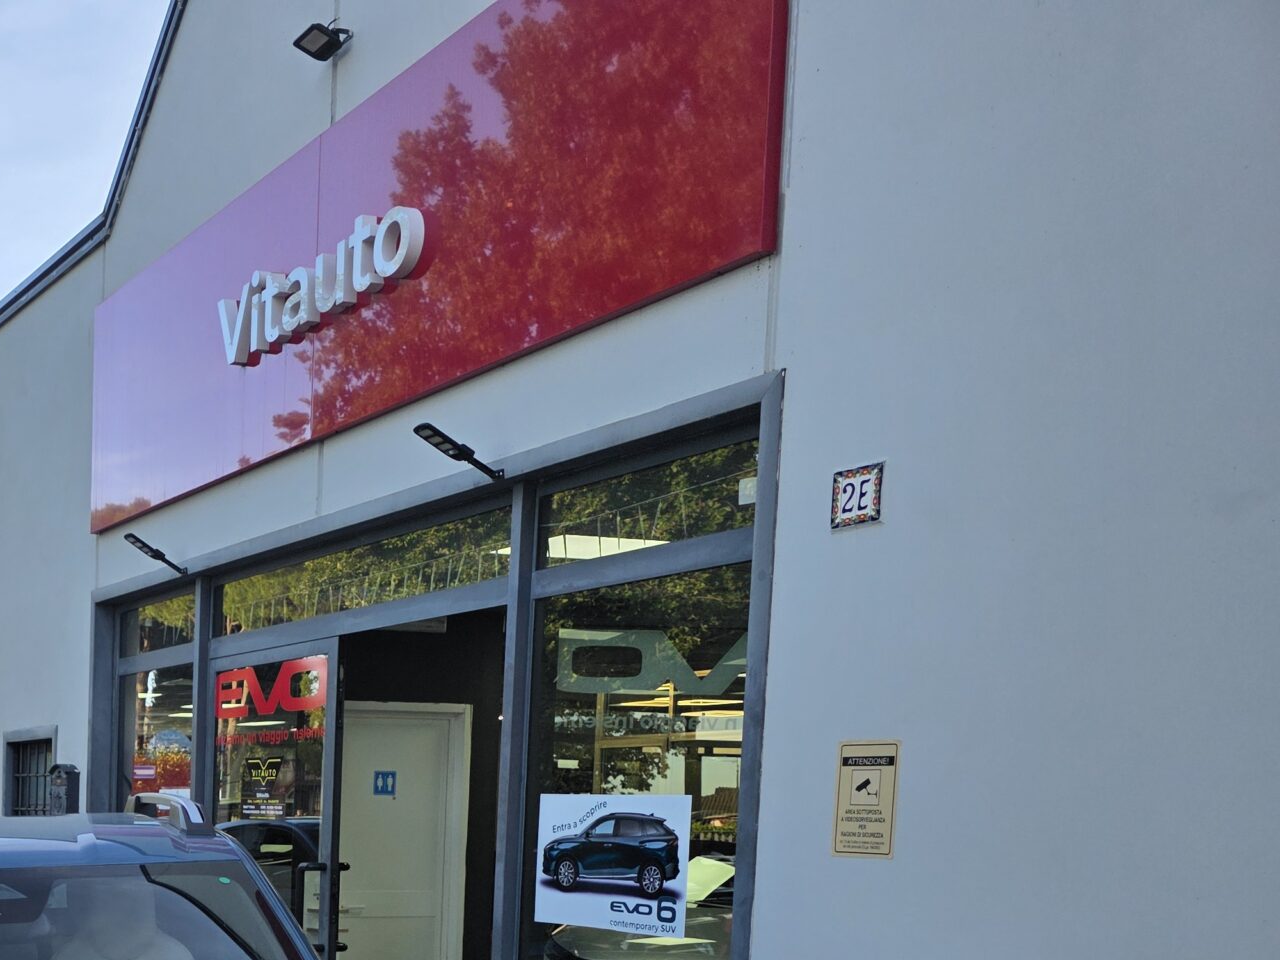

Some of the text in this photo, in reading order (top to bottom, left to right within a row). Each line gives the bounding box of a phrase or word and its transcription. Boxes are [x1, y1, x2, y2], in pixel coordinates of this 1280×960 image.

[217, 205, 426, 367] Vitauto
[841, 478, 871, 514] 2E
[216, 655, 328, 720] EVO
[258, 727, 289, 745] viaggio
[291, 726, 326, 742] nsieme
[251, 768, 277, 778] VITAUTO
[552, 822, 572, 834] Entra
[579, 800, 608, 825] scoprire
[609, 896, 677, 924] EVO 6
[609, 919, 677, 934] contemporary SUV
